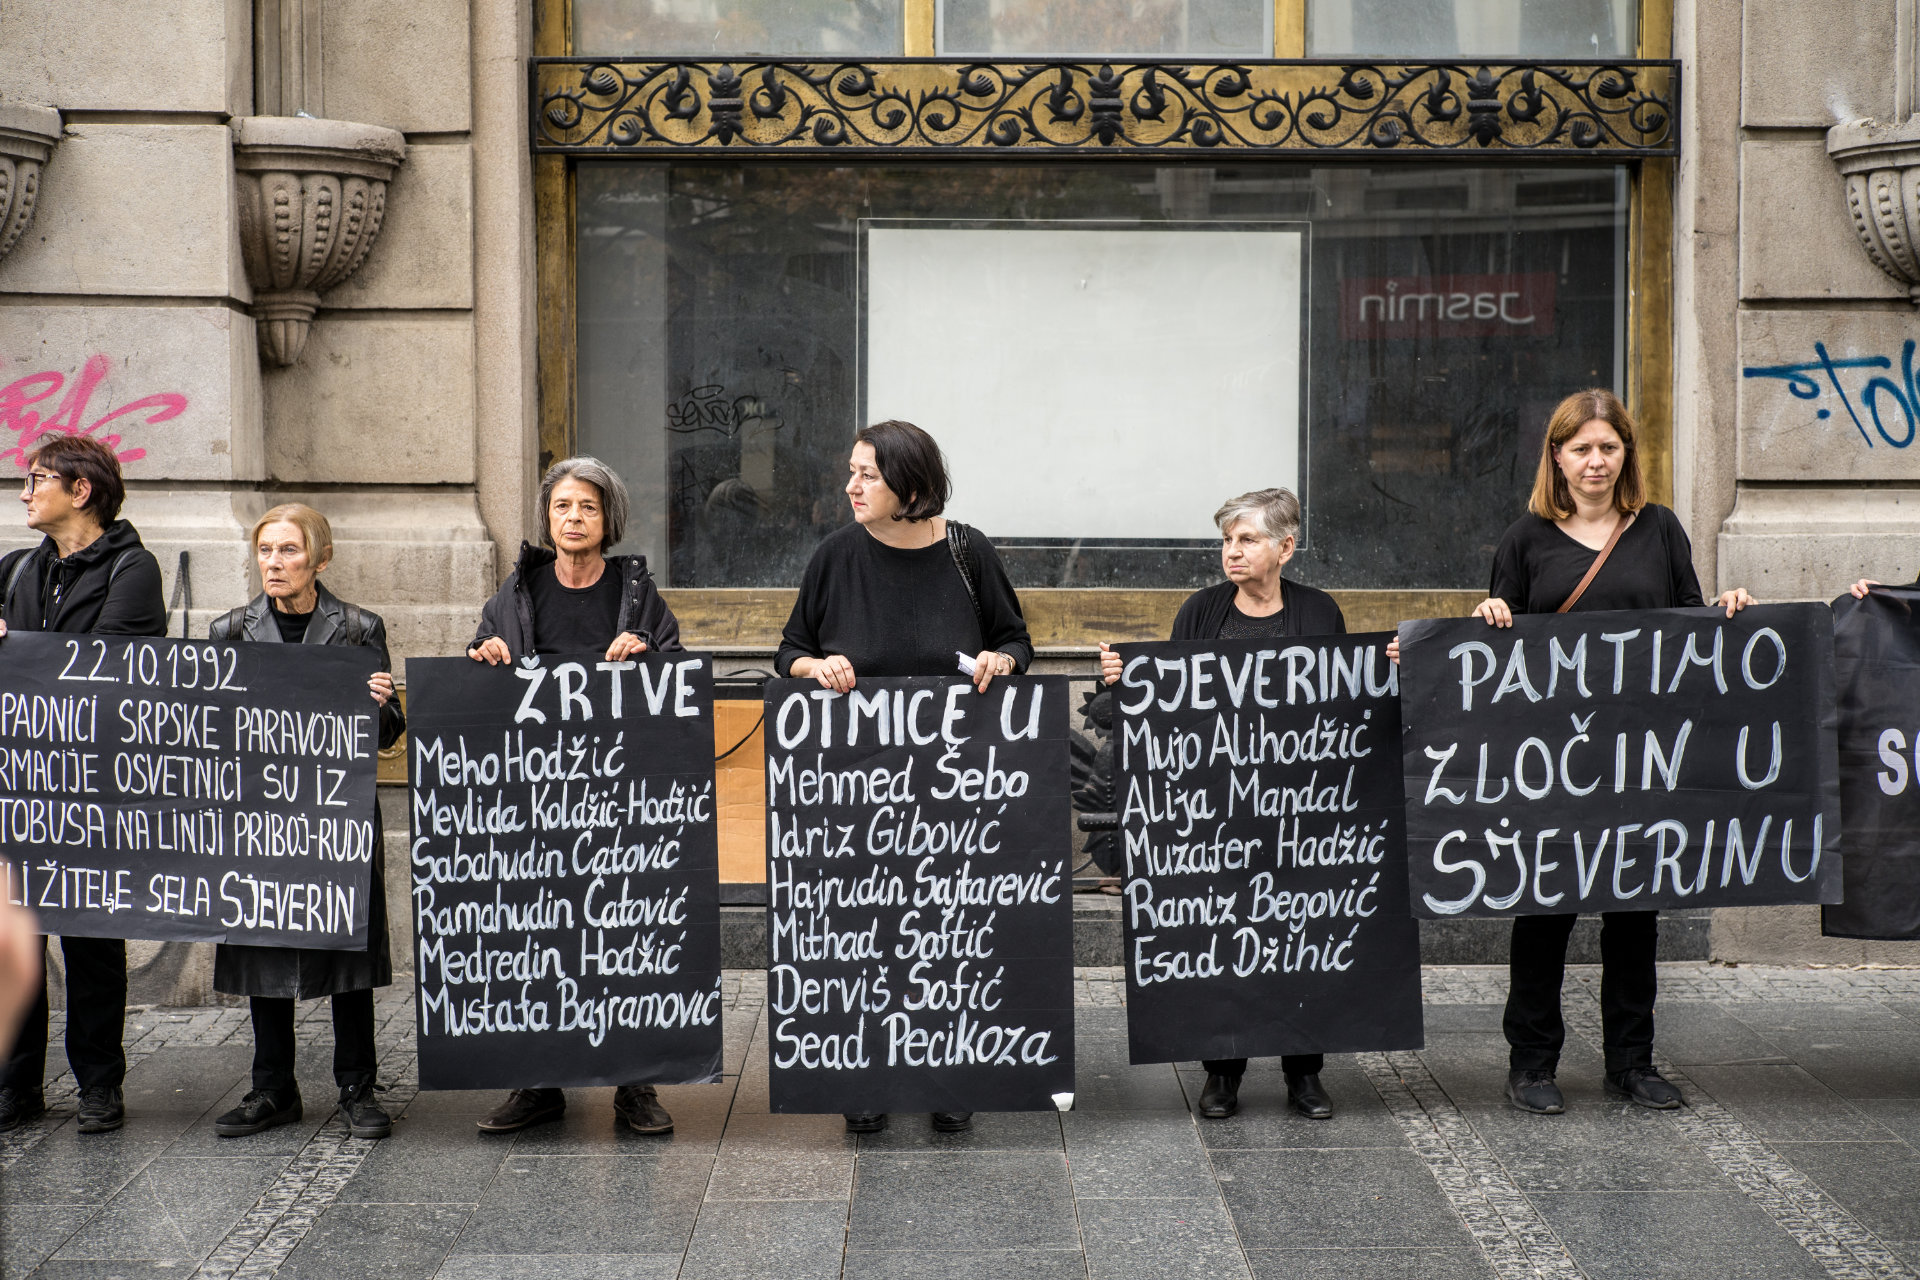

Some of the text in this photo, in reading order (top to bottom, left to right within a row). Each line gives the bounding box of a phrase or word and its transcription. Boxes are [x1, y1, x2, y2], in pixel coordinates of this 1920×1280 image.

[58, 640, 247, 692] 22.10.1992.
[514, 654, 702, 724] ŽRTVE
[1120, 646, 1400, 715] SJEVERINU
[1449, 626, 1787, 711] PAMTIMO
[119, 699, 220, 750] SRPSKE
[235, 706, 370, 760] PARAVOJNE
[776, 684, 1043, 749] OTMICE U
[115, 752, 241, 801] OSVETNICI
[263, 764, 298, 802] SU
[317, 764, 348, 806] IZ
[415, 729, 625, 788] Meho Hodžić
[769, 744, 1029, 806] Mehmed Šebo
[1123, 718, 1201, 782] Mujo
[1424, 711, 1781, 806] ZLOČIN U
[414, 778, 711, 836] Mevlida Koldžić-Hodžić
[772, 803, 1007, 858] Idriz Gibović
[1122, 765, 1359, 837] Alija Mandal
[117, 809, 150, 850] NA
[159, 808, 222, 856] LINIJI
[234, 811, 373, 862] PRIBOJ-RUDO
[412, 835, 566, 885] Sabahudin
[1124, 817, 1388, 879] Muzafer Hadžić
[1422, 813, 1823, 915] SJEVERINU
[146, 874, 209, 916] SELA
[220, 871, 354, 936] SJEVERIN
[412, 881, 574, 935] Ramahudin
[772, 856, 1063, 920] Hajrudin Sajtarević
[1124, 872, 1380, 932] Ramiz Begović
[419, 929, 686, 984] Medredin Hodžić
[772, 911, 882, 962] Mithad
[1134, 923, 1360, 987] Esad Džihić
[421, 975, 721, 1047] Mustafa Bajramović
[771, 959, 1004, 1015] Derviš Sofić
[775, 1010, 1059, 1070] Sead Pecikoza
